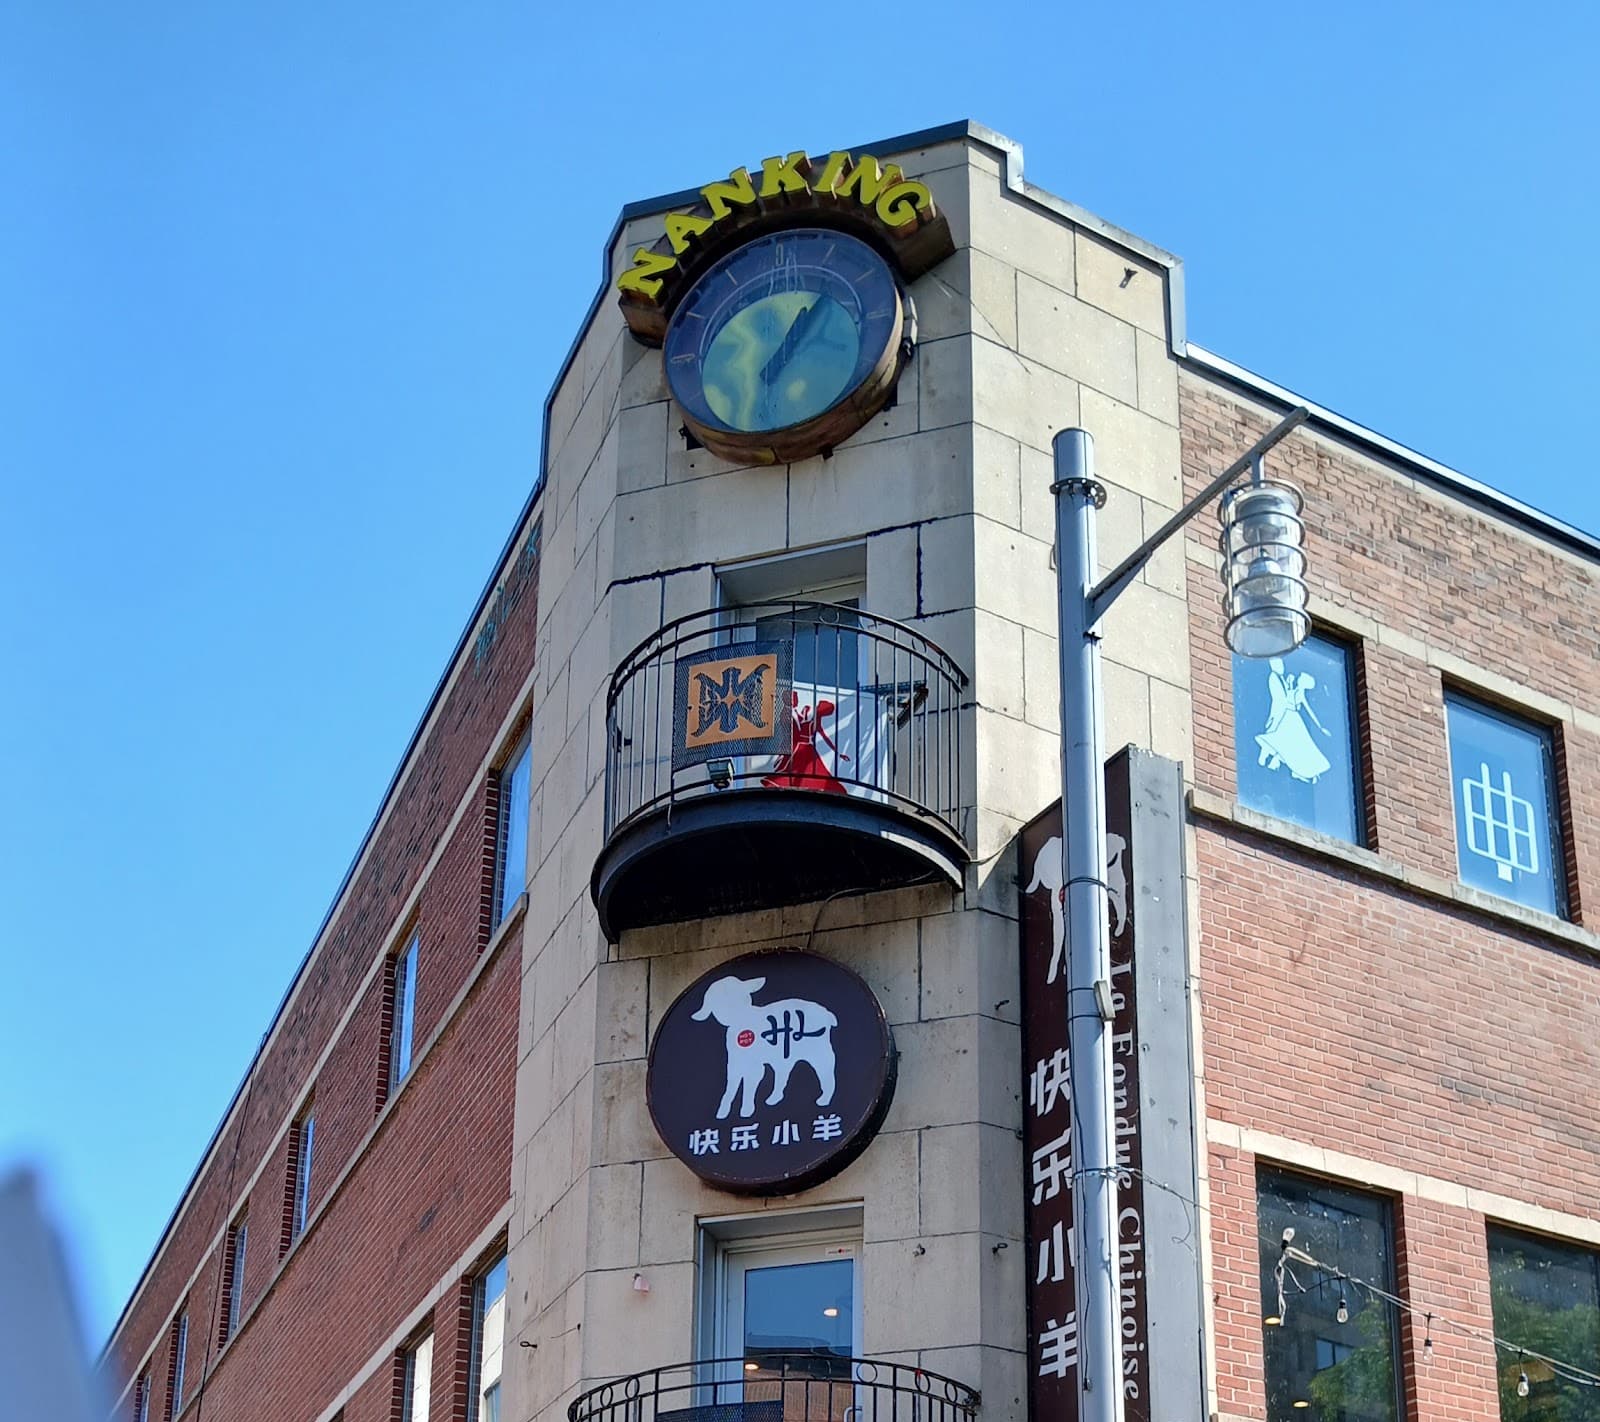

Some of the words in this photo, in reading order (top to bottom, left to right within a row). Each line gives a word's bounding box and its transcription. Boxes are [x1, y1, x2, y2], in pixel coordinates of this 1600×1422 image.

[617, 150, 932, 300] NANKING
[688, 1113, 844, 1156] 快乐小羊
[1112, 1028, 1137, 1191] Fondue
[1118, 1207, 1145, 1400] Chinoise
